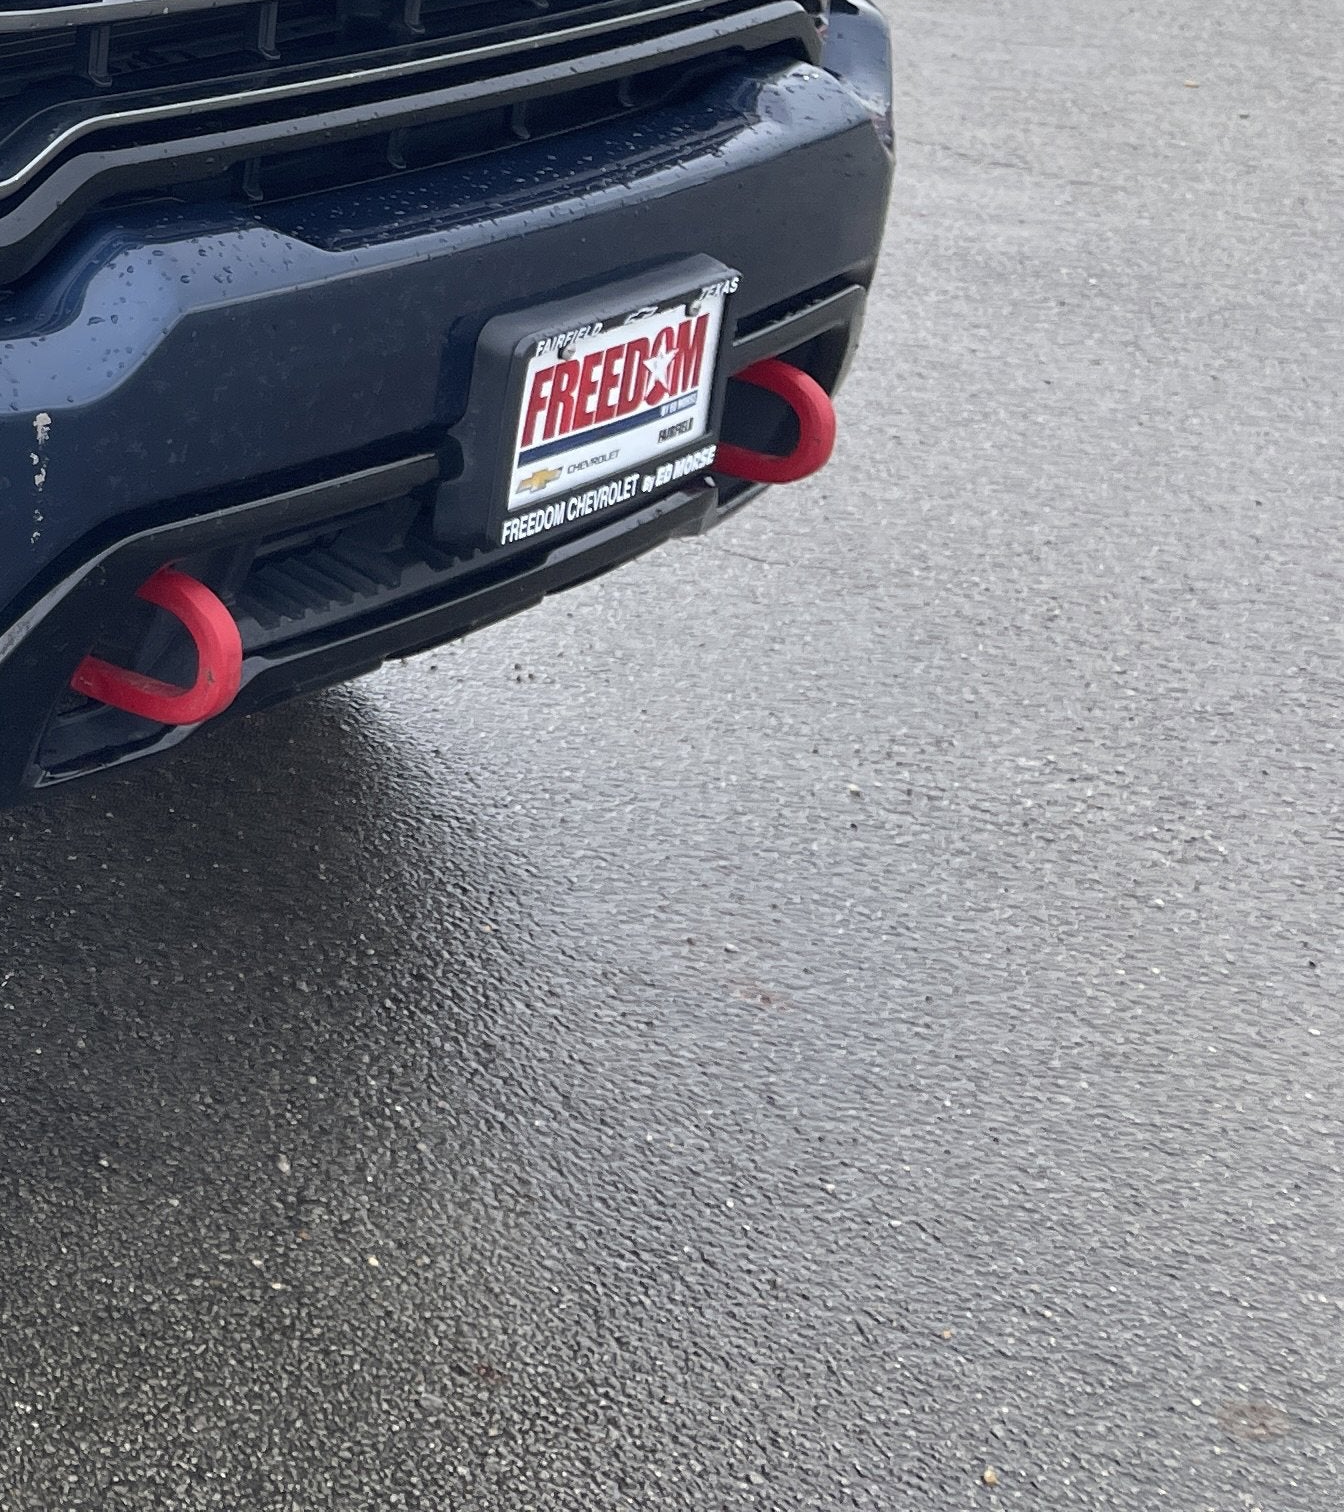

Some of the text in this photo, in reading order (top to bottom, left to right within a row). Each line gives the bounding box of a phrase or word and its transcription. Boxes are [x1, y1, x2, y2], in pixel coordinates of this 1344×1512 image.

[699, 277, 740, 302] TEXAS
[535, 322, 604, 358] FAIRFIELD
[520, 312, 711, 449] FREEDOM
[567, 449, 621, 475] CHEVROLET
[500, 501, 567, 546] FREEDOM
[565, 474, 640, 522] CHEVROLET
[655, 463, 674, 488] ED
[672, 444, 717, 479] MORSE
